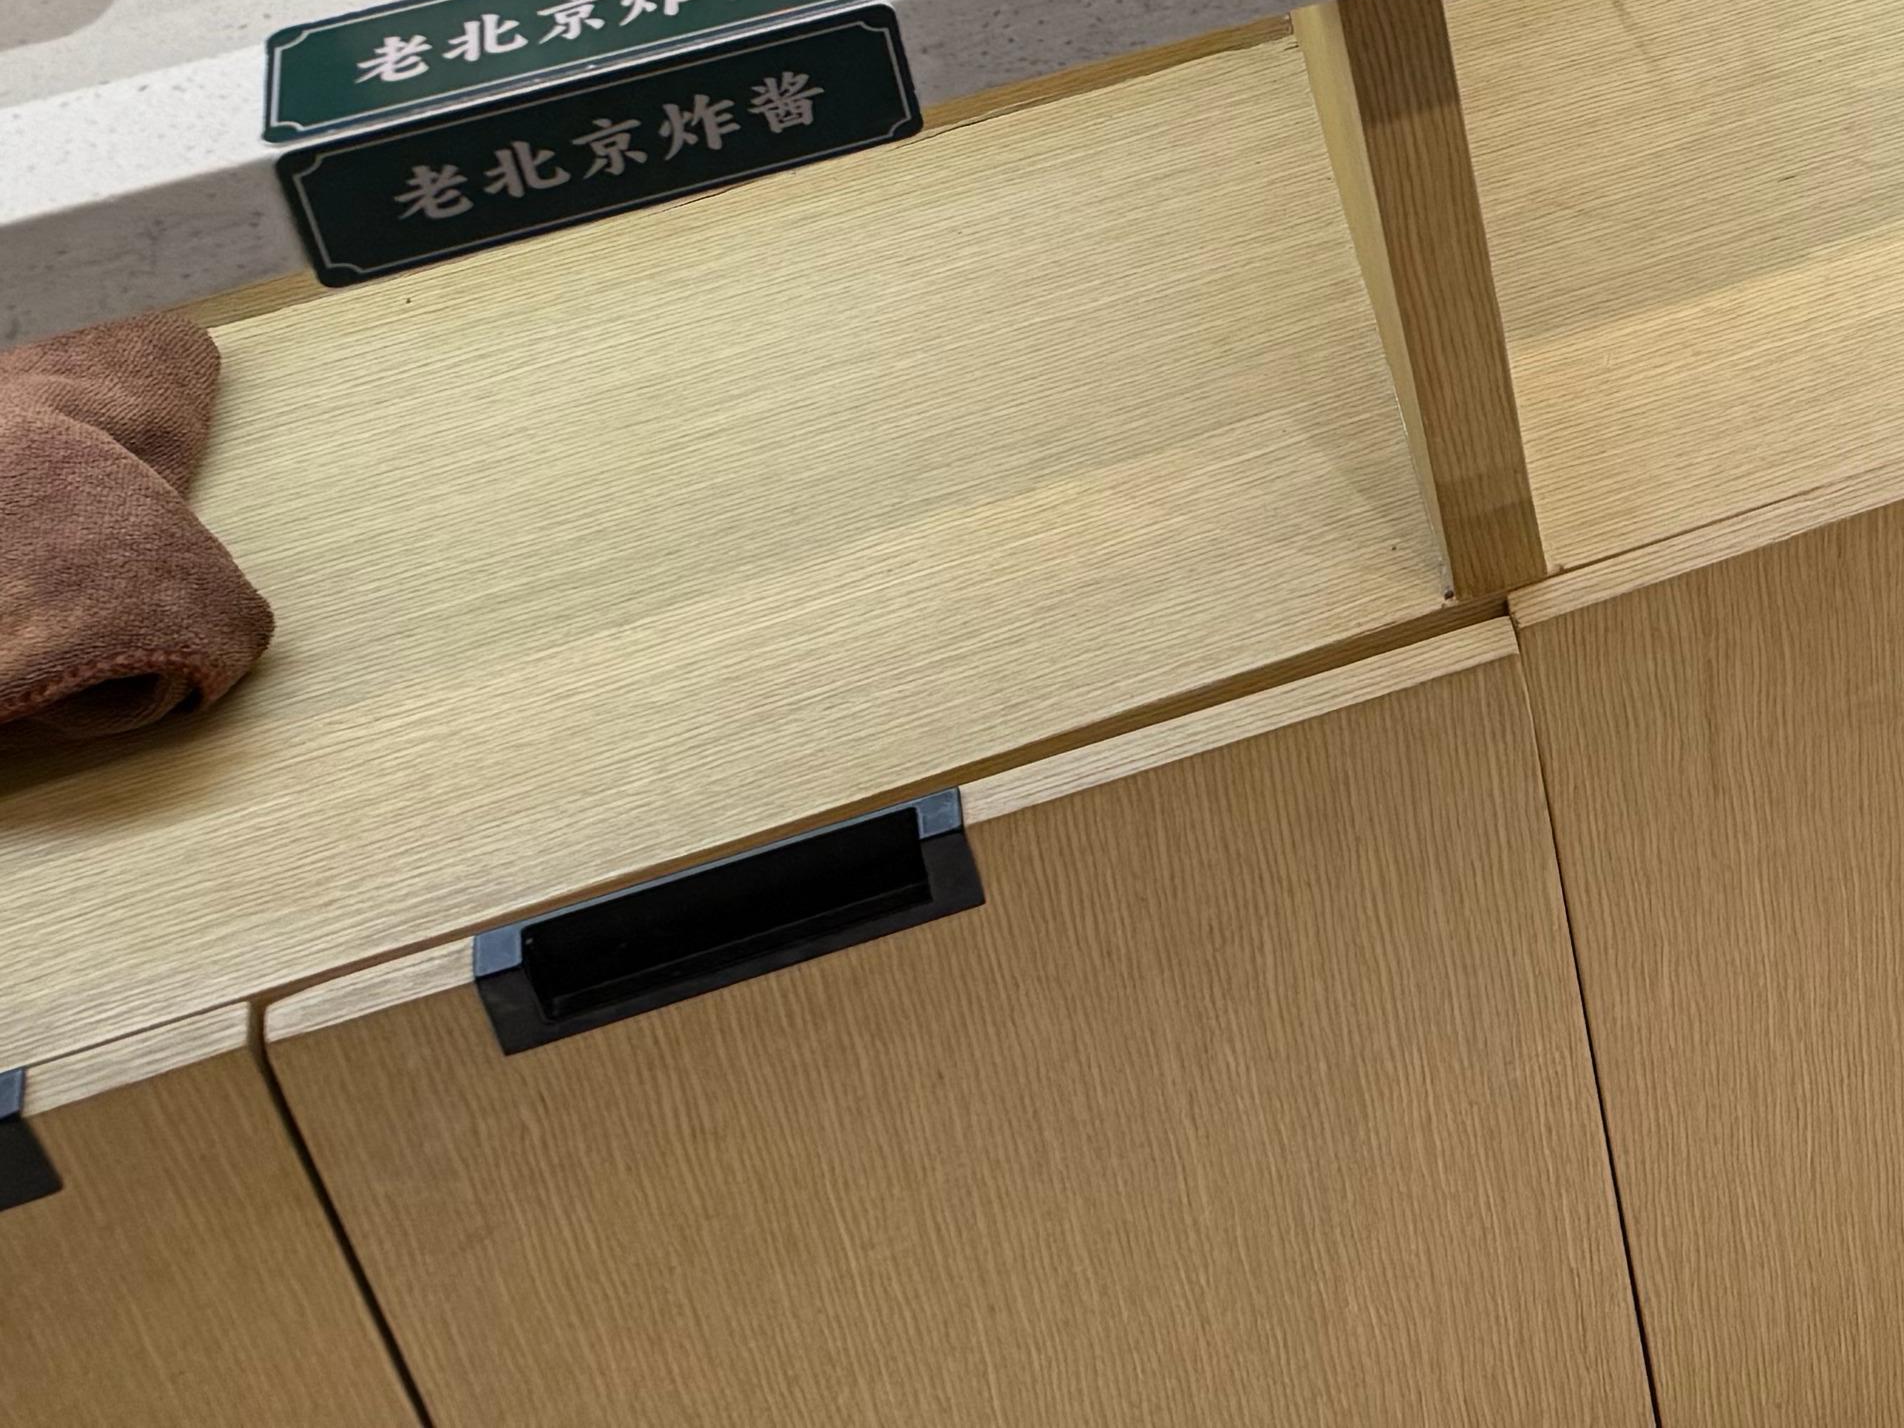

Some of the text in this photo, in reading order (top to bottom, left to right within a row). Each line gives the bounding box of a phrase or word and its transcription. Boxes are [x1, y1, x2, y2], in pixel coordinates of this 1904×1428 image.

[393, 71, 825, 223] 老北京炸酱
